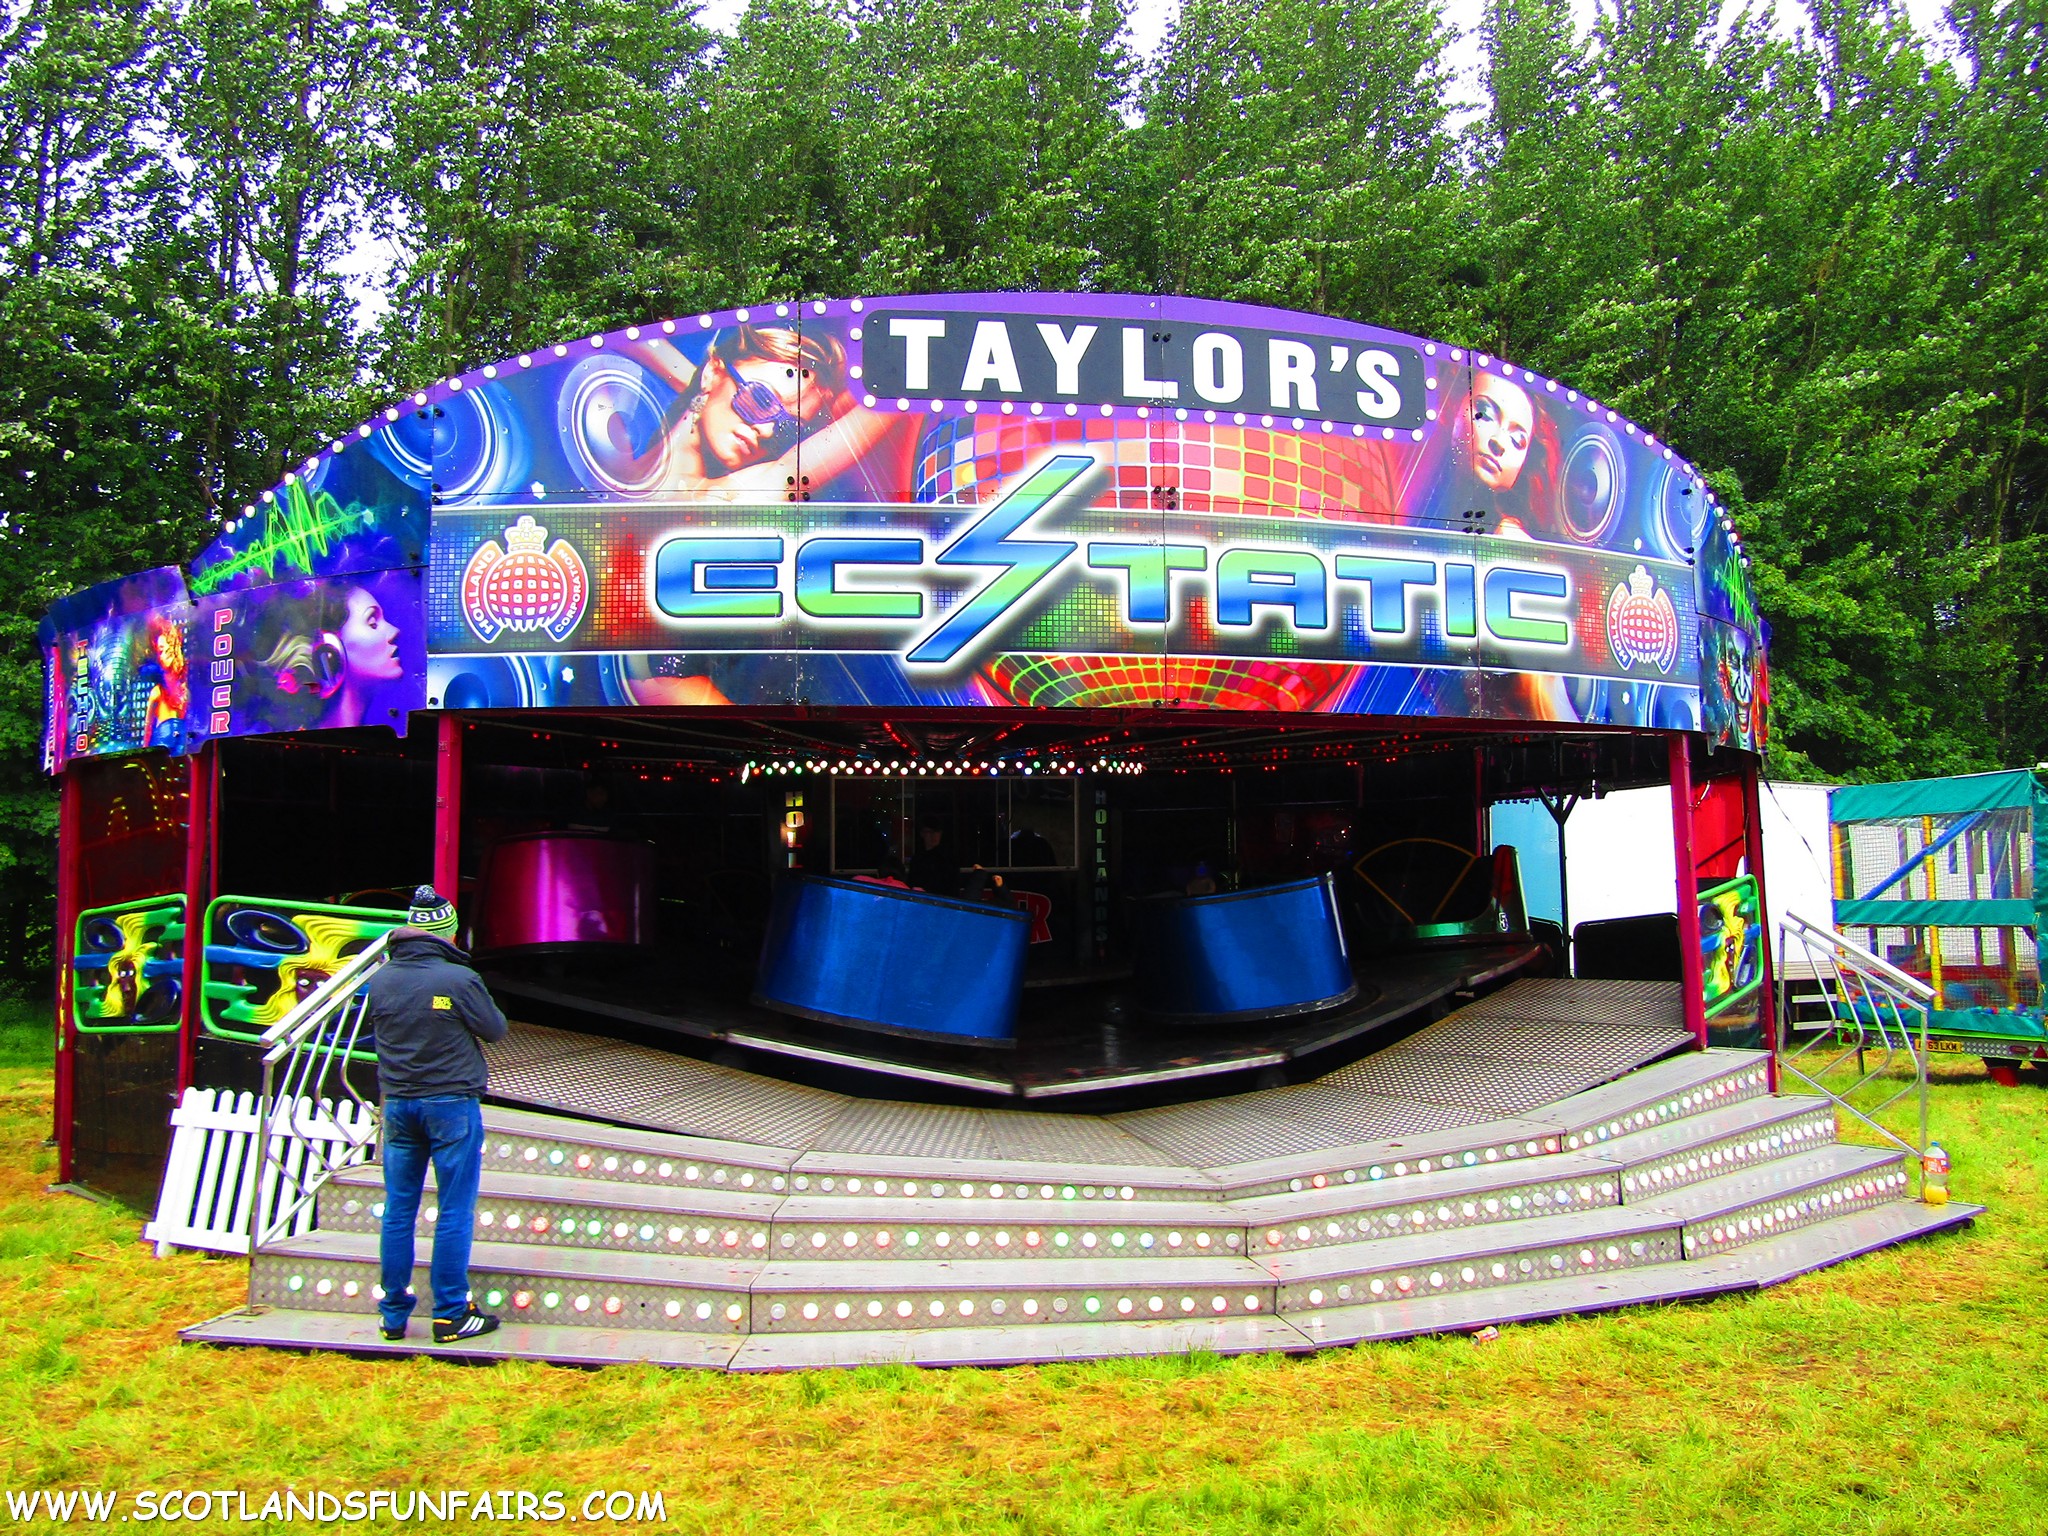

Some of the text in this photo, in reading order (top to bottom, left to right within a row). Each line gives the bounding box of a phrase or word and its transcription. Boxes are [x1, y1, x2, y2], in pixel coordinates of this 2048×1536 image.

[889, 318, 1402, 420] TAYLOR'S
[468, 550, 497, 635] HOLLAND
[554, 549, 583, 634] CORPORATION
[1610, 591, 1628, 663] HOLLAND
[75, 639, 90, 752] TECHNO
[210, 608, 234, 735] POWER
[1498, 912, 1509, 932] 5
